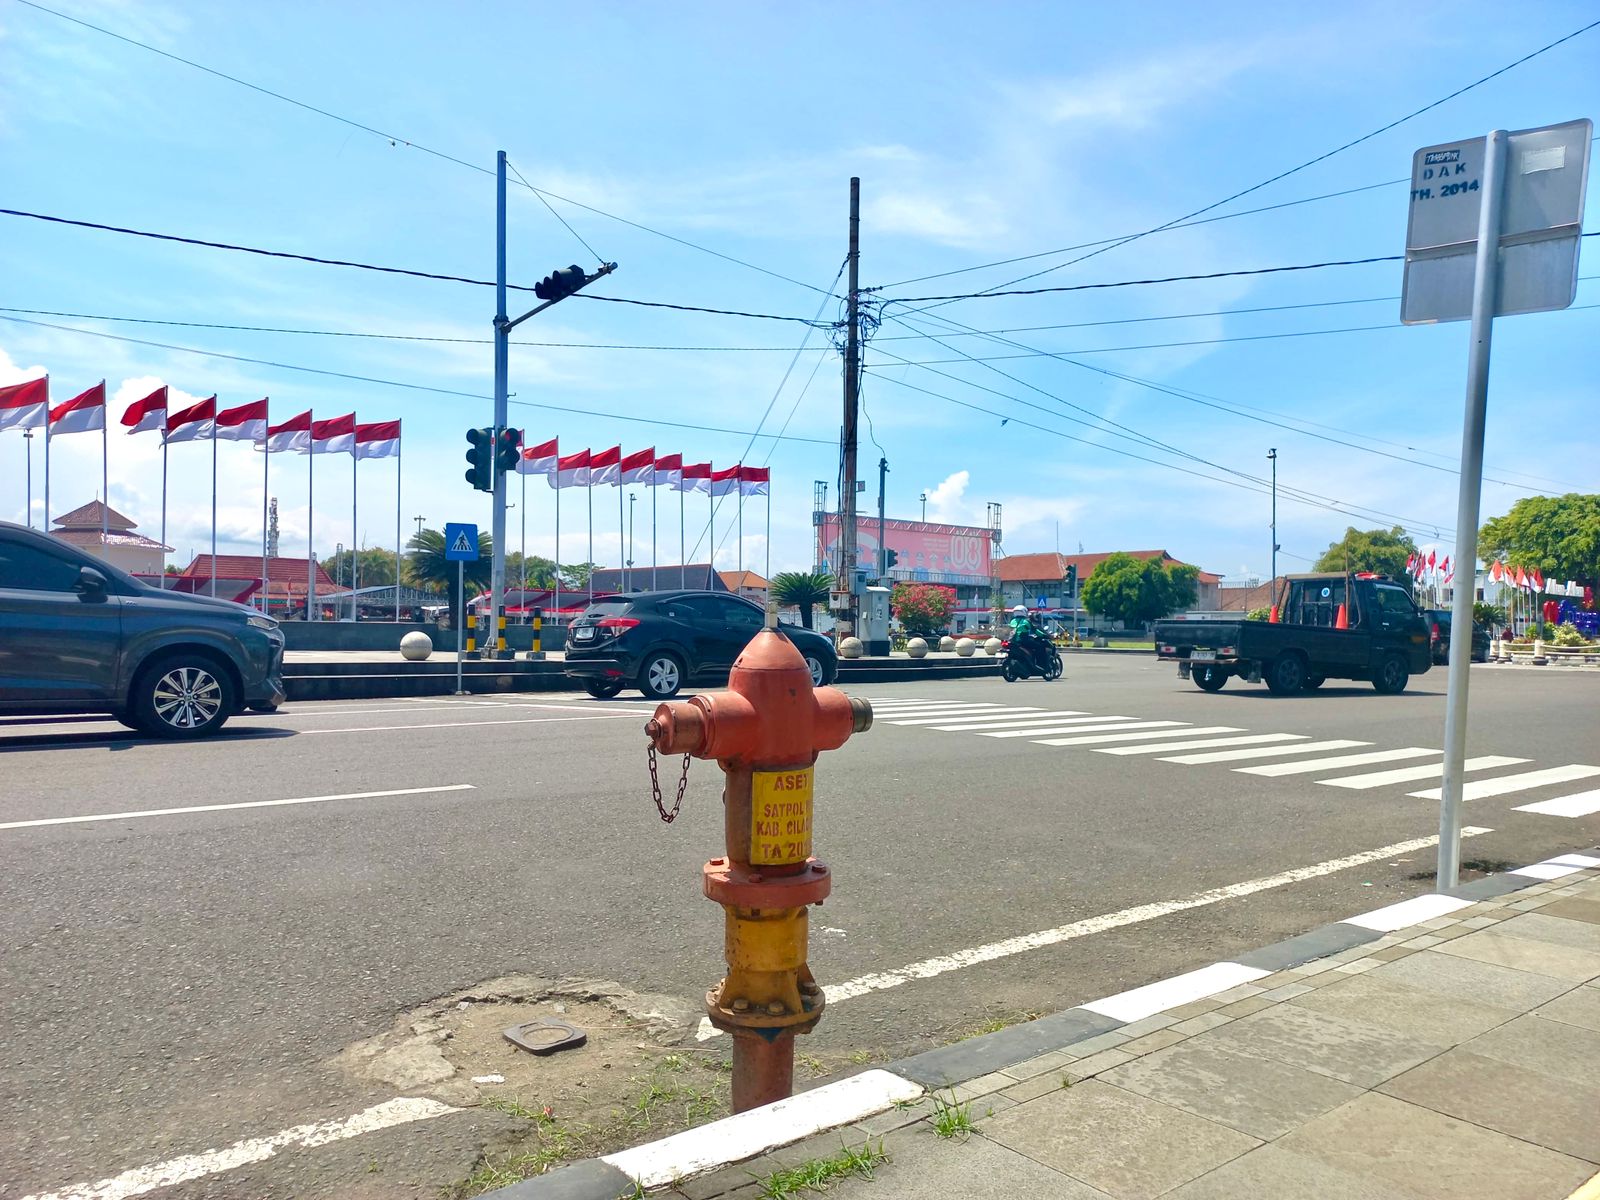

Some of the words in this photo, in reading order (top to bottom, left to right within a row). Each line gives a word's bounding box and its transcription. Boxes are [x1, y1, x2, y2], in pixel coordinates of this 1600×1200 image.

[1423, 162, 1466, 180] DAK
[1411, 188, 1435, 202] TH.
[1441, 179, 1479, 198] 2014
[764, 802, 804, 818] SATPOL
[756, 821, 782, 837] KAB.
[762, 843, 781, 858] TA
